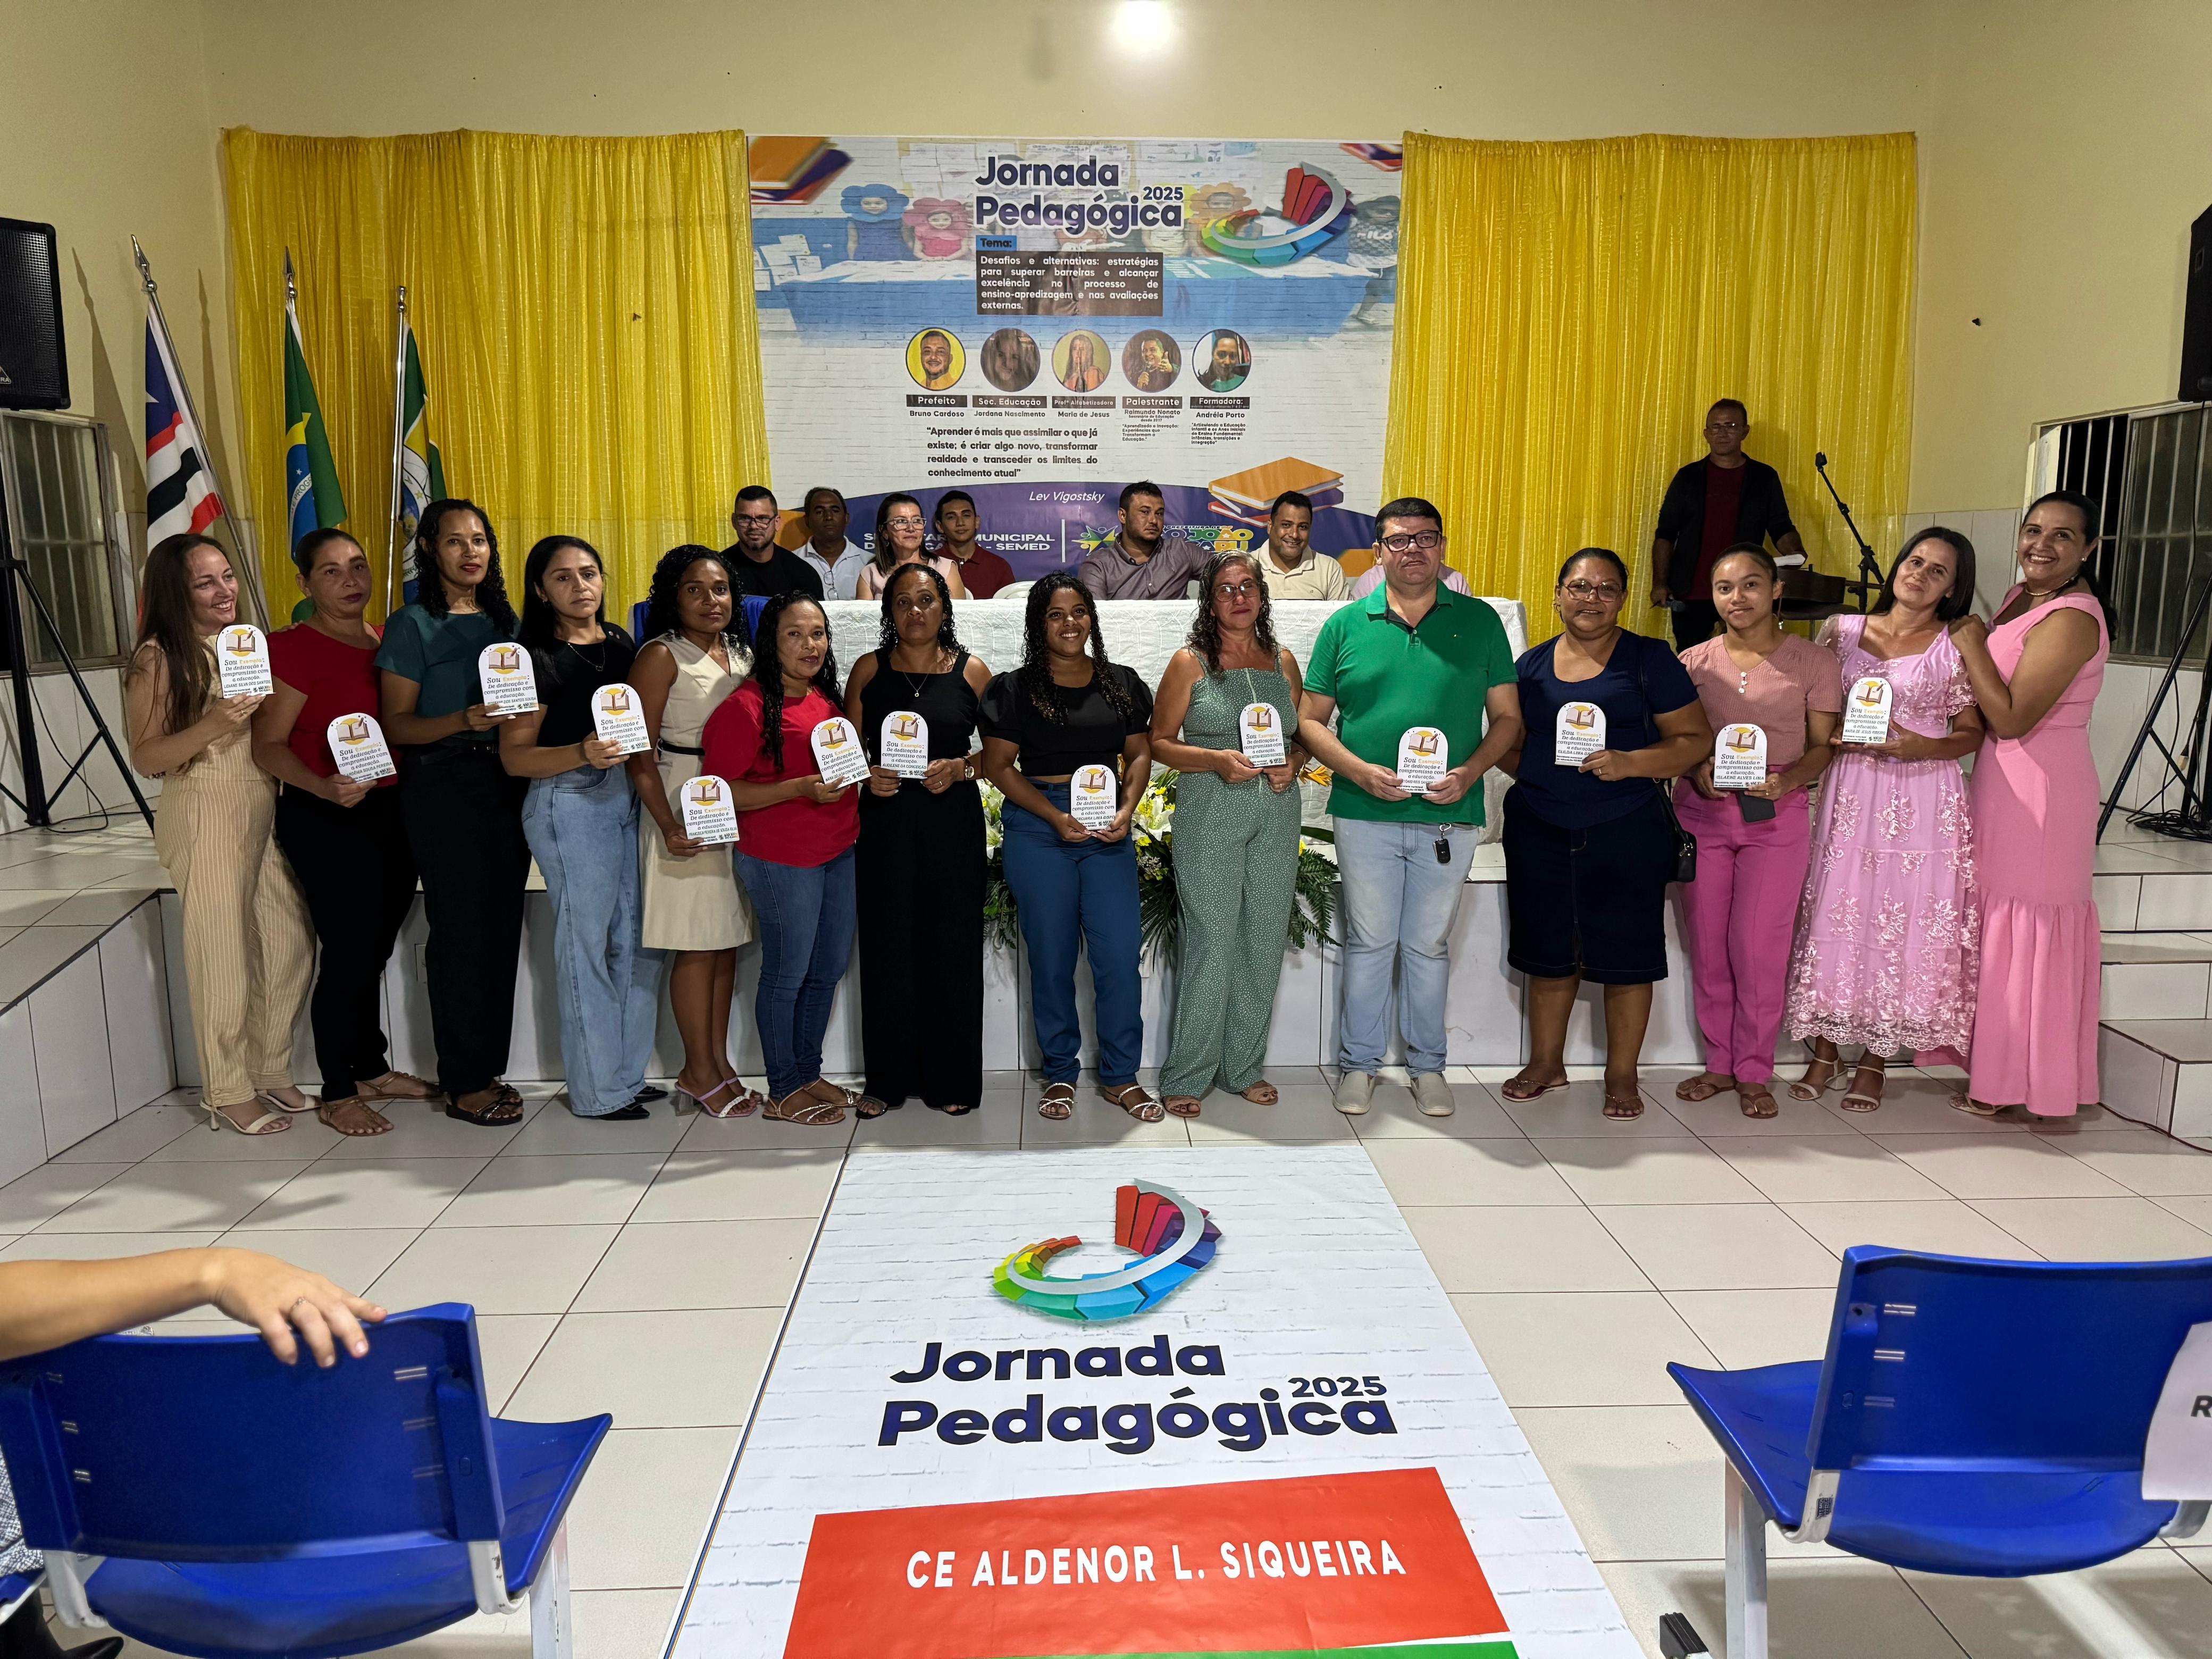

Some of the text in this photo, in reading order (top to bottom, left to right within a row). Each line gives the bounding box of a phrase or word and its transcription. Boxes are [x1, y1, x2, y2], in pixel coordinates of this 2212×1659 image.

[975, 156, 1118, 187] Jornada
[1143, 187, 1183, 200] 2025
[976, 194, 1181, 235] Pedagógica
[981, 238, 1012, 247] Tema:
[981, 256, 1020, 265] Desafios
[1043, 256, 1099, 265] alternativas:
[1108, 257, 1159, 267] estratégias
[1054, 269, 1094, 277] barreiras
[1119, 270, 1158, 279] alcançar
[981, 279, 1030, 287] excelência
[982, 290, 1073, 300] ensino-apredizagem
[1110, 291, 1158, 300] avaliações
[999, 398, 1041, 407] Educação
[975, 427, 980, 435] é
[1005, 429, 1021, 438] que
[1089, 428, 1097, 438] já
[927, 441, 957, 450] existe;
[995, 441, 1014, 451] algo
[928, 455, 967, 463] realdade
[984, 455, 1032, 464] transceder
[1029, 491, 1104, 503] Lev Vigostsky
[1187, 526, 1253, 540] JOÃO
[831, 752, 853, 763] dedicação
[821, 758, 852, 772] compromisso
[889, 1335, 1225, 1382] Jornada
[1292, 1376, 1387, 1398] 2025
[878, 1386, 1398, 1454] Pedagógica
[906, 1539, 1406, 1588] CE ALDENOR L. SIQUEIRA
